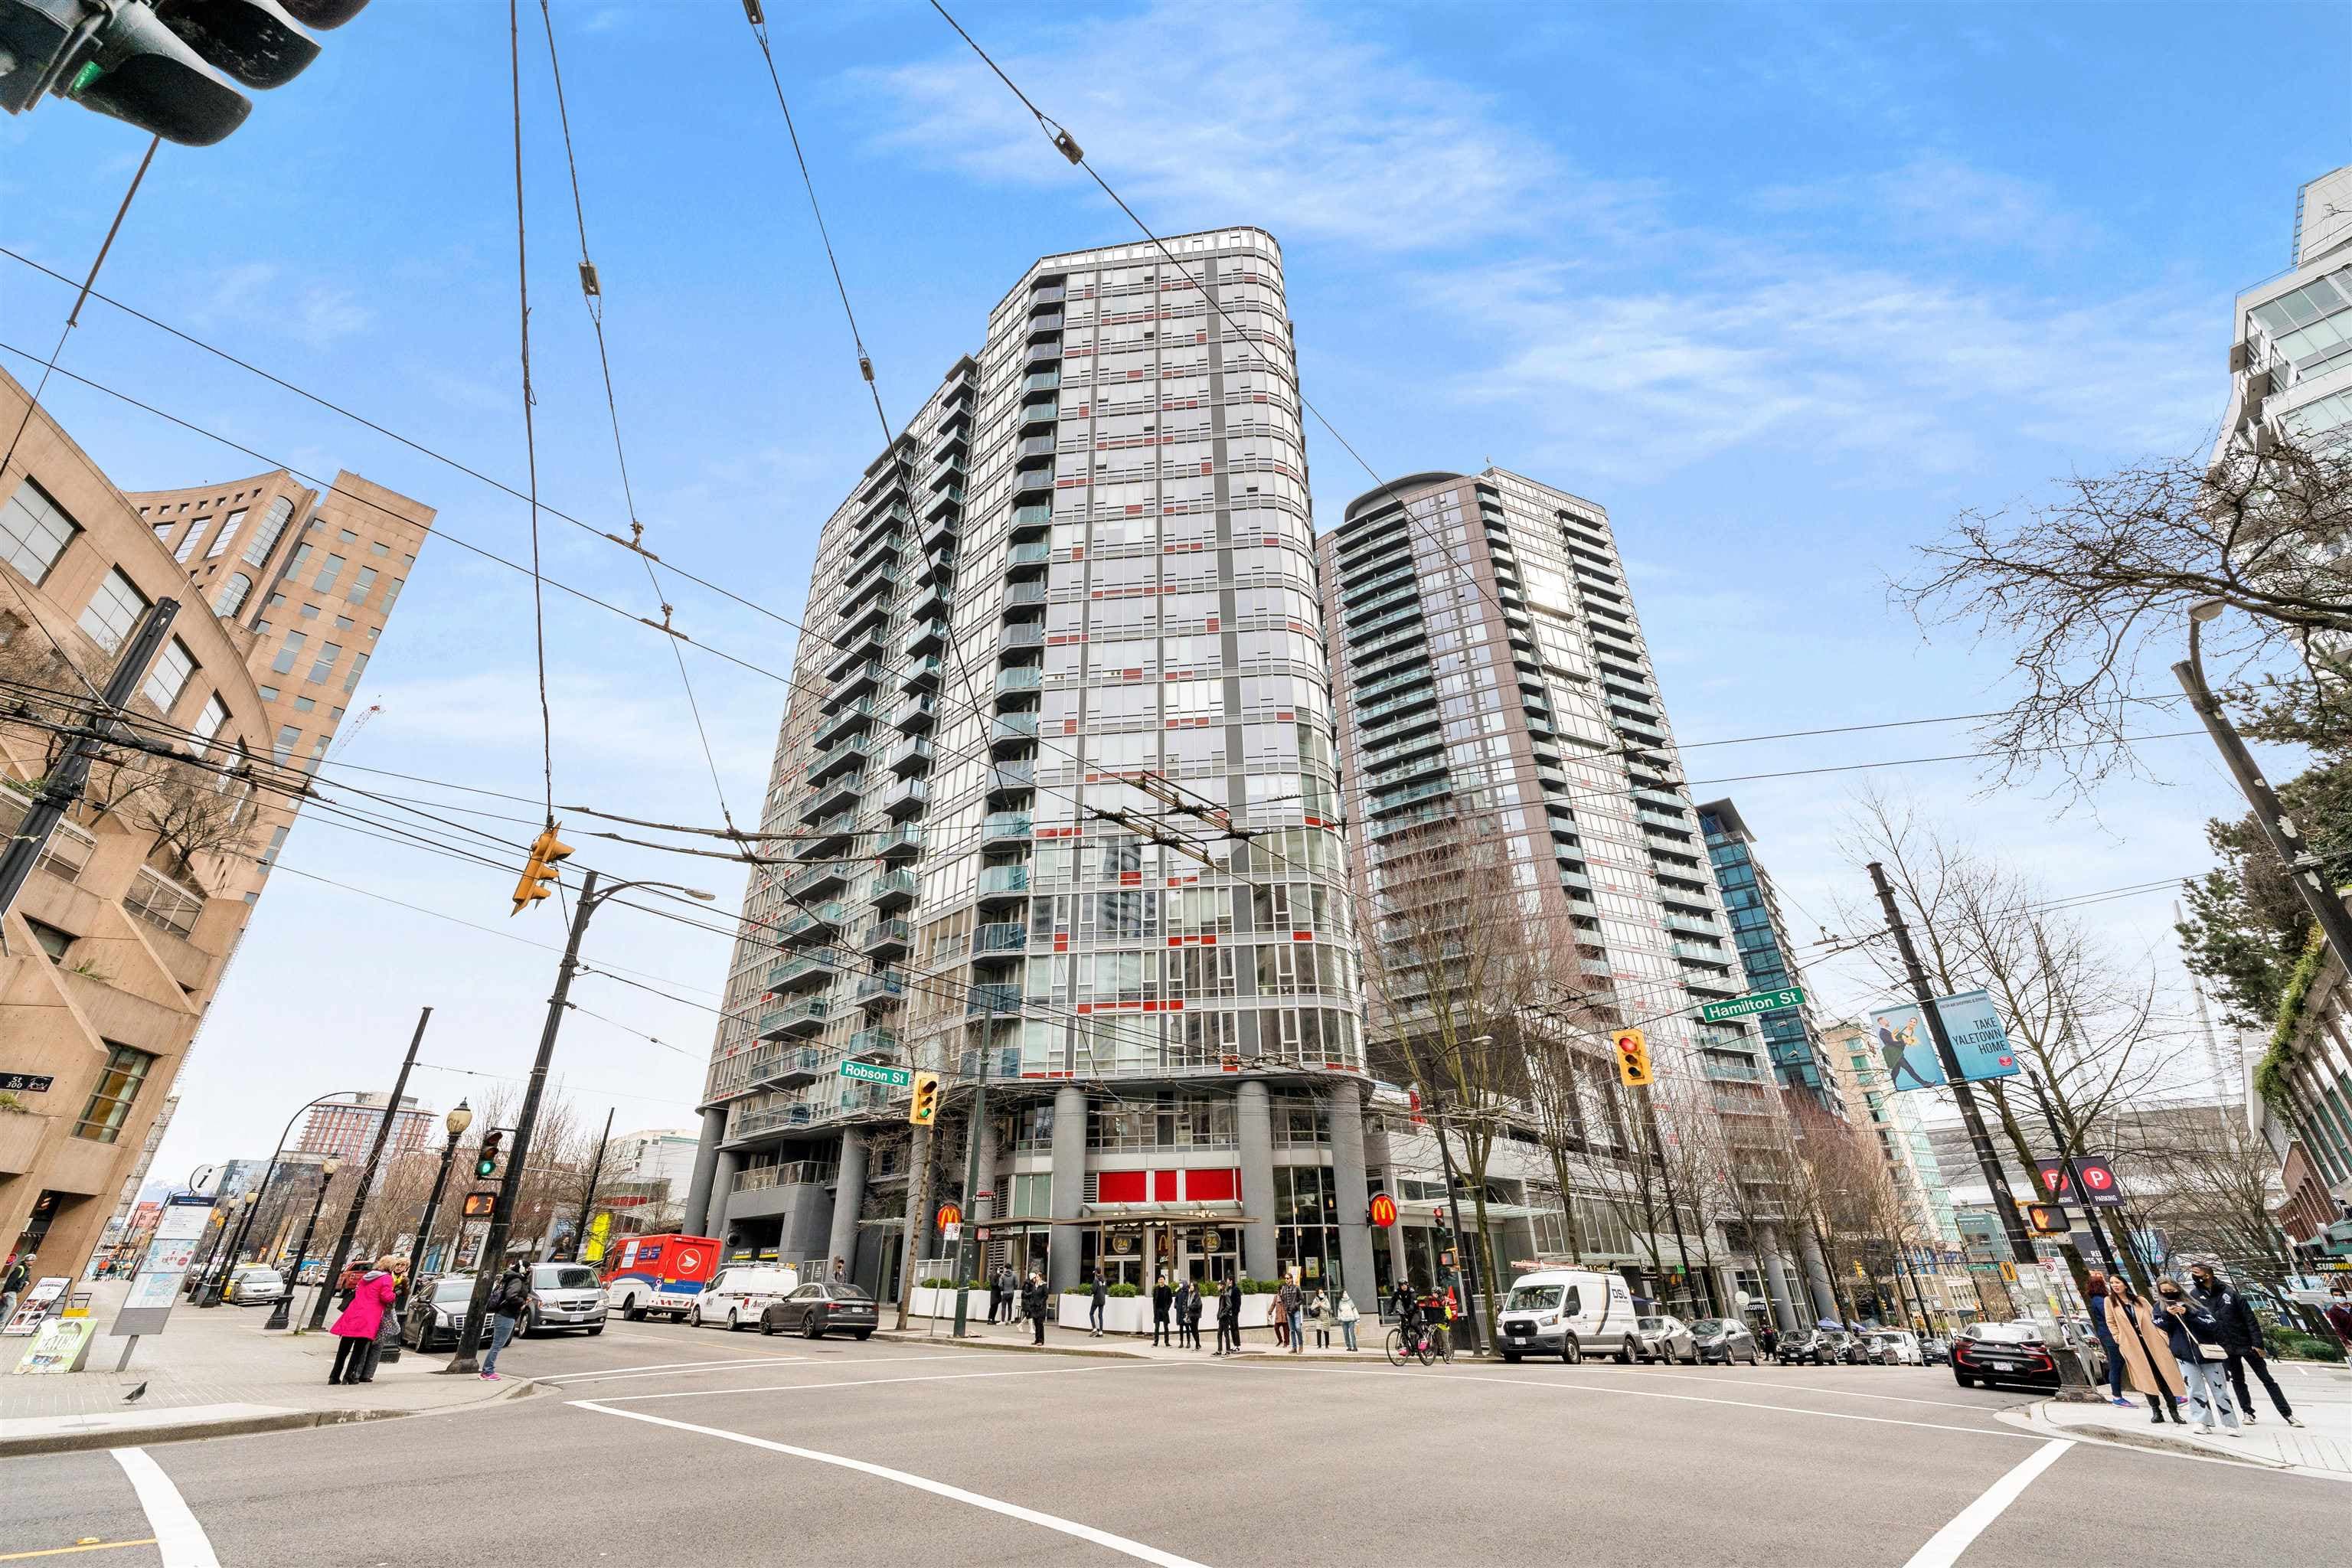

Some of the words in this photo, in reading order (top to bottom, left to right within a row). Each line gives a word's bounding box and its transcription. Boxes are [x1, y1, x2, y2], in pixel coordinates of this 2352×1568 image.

[1709, 998, 1775, 1018] Hamilton
[1779, 991, 1798, 1004] St
[1973, 1017, 1998, 1031] TAKE
[1952, 1029, 2003, 1046] YALETOWN
[1978, 1040, 2008, 1055] HOME
[845, 1063, 888, 1081] Robson
[892, 1072, 904, 1083] St
[2089, 1171, 2104, 1187] P
[483, 1197, 494, 1213] 3
[1612, 1289, 1628, 1299] DSL
